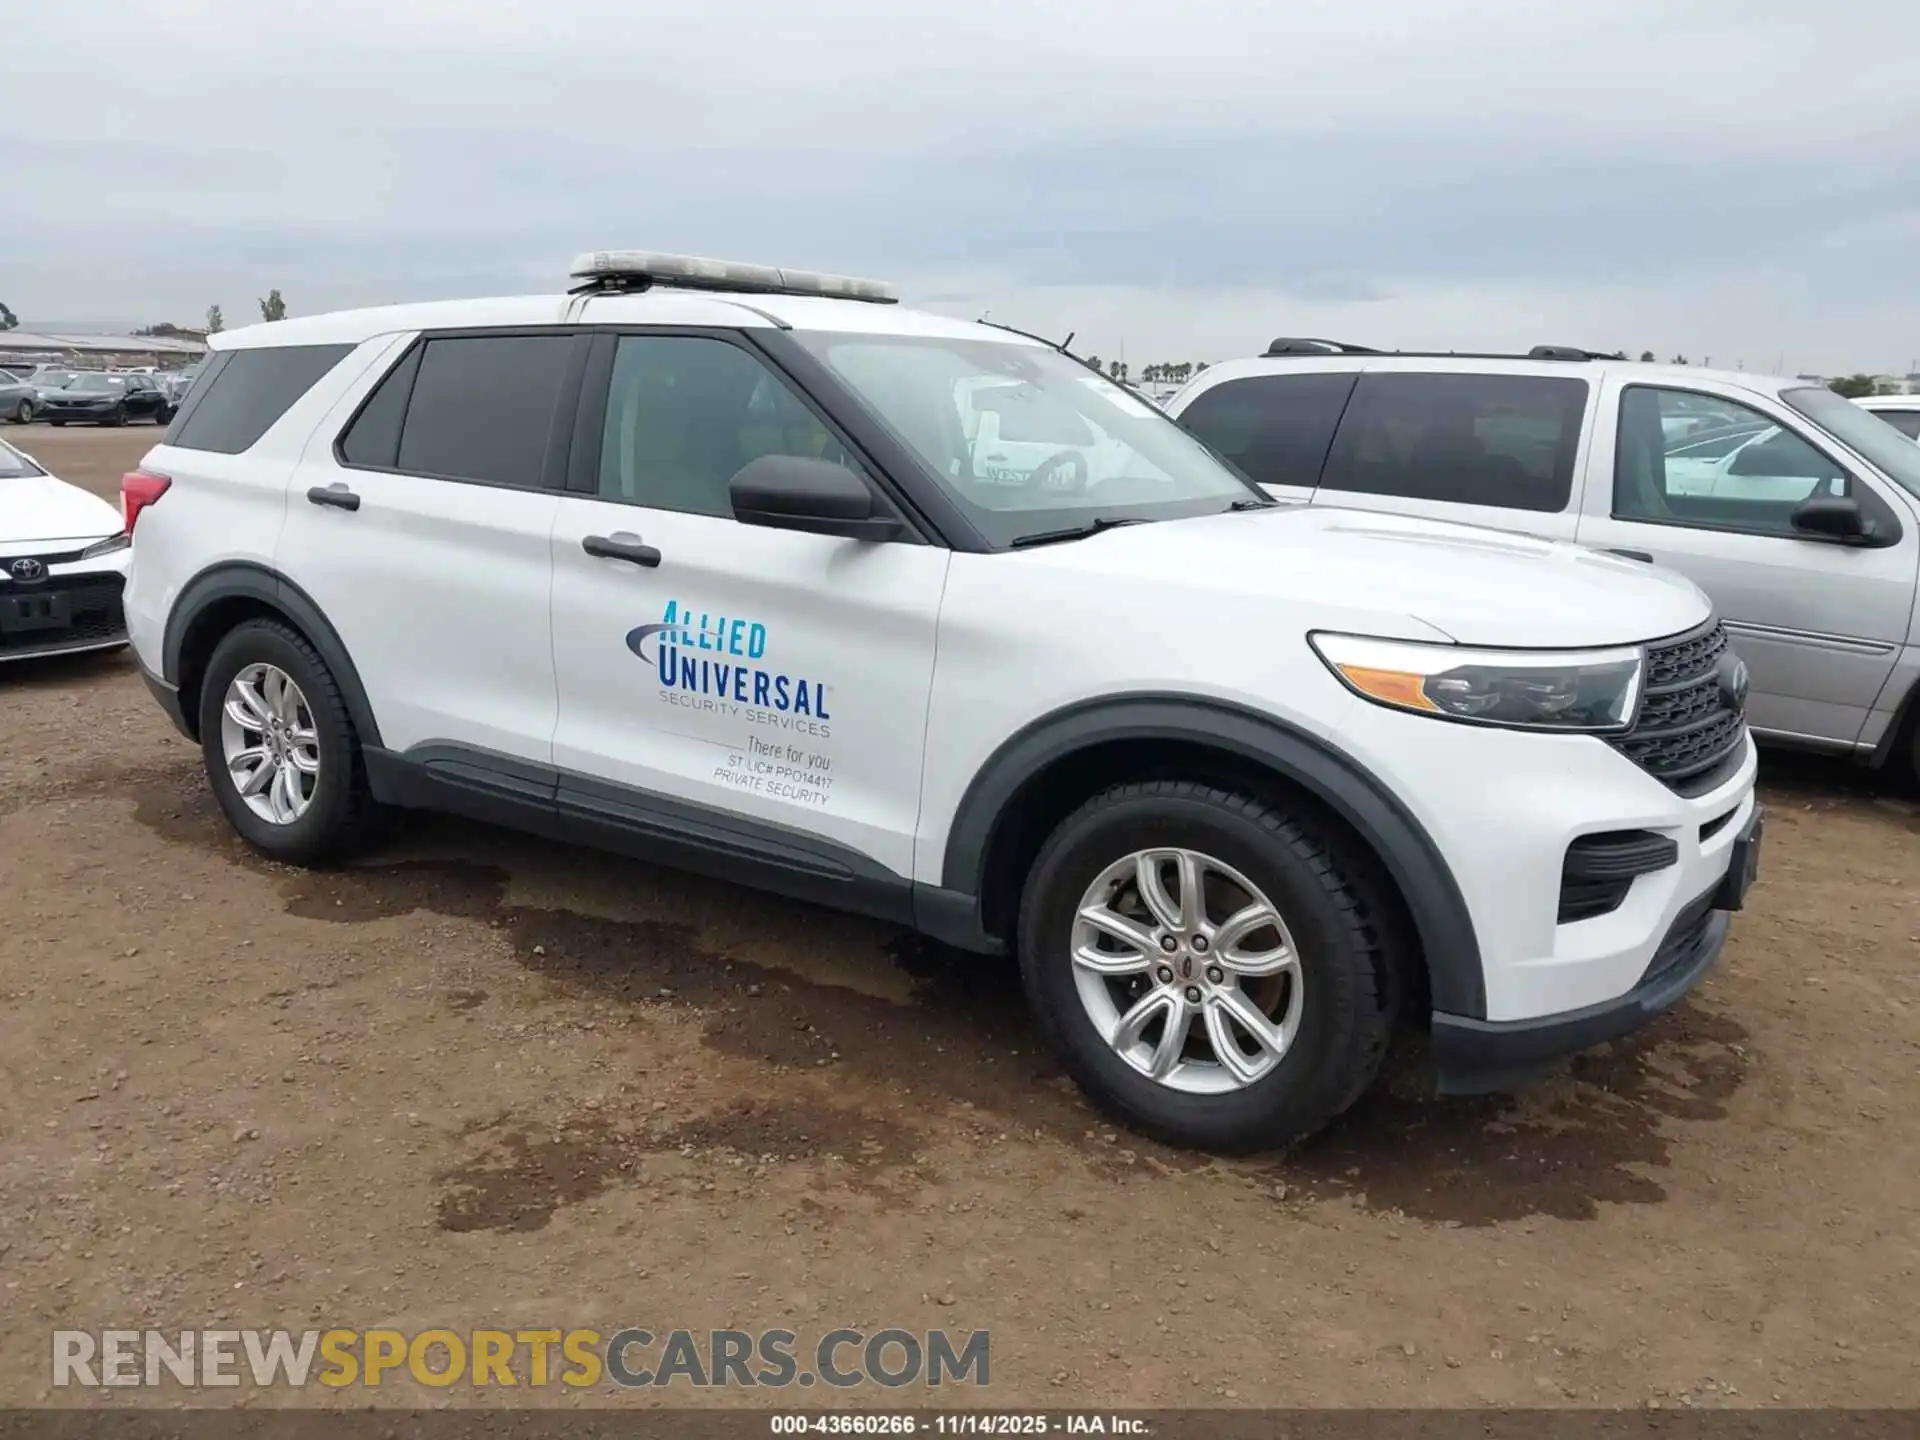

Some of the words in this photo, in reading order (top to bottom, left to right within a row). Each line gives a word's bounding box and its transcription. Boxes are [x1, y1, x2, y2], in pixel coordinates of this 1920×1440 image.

[659, 600, 766, 659] ALLIED
[659, 644, 830, 720] UNIVERSAL
[659, 690, 739, 717] SECURITY
[746, 709, 831, 739] SERVICES
[728, 754, 743, 768] ST
[748, 735, 782, 759] There
[786, 745, 804, 763] for
[713, 767, 763, 790] PRIVATE
[766, 780, 831, 805] SECURITY
